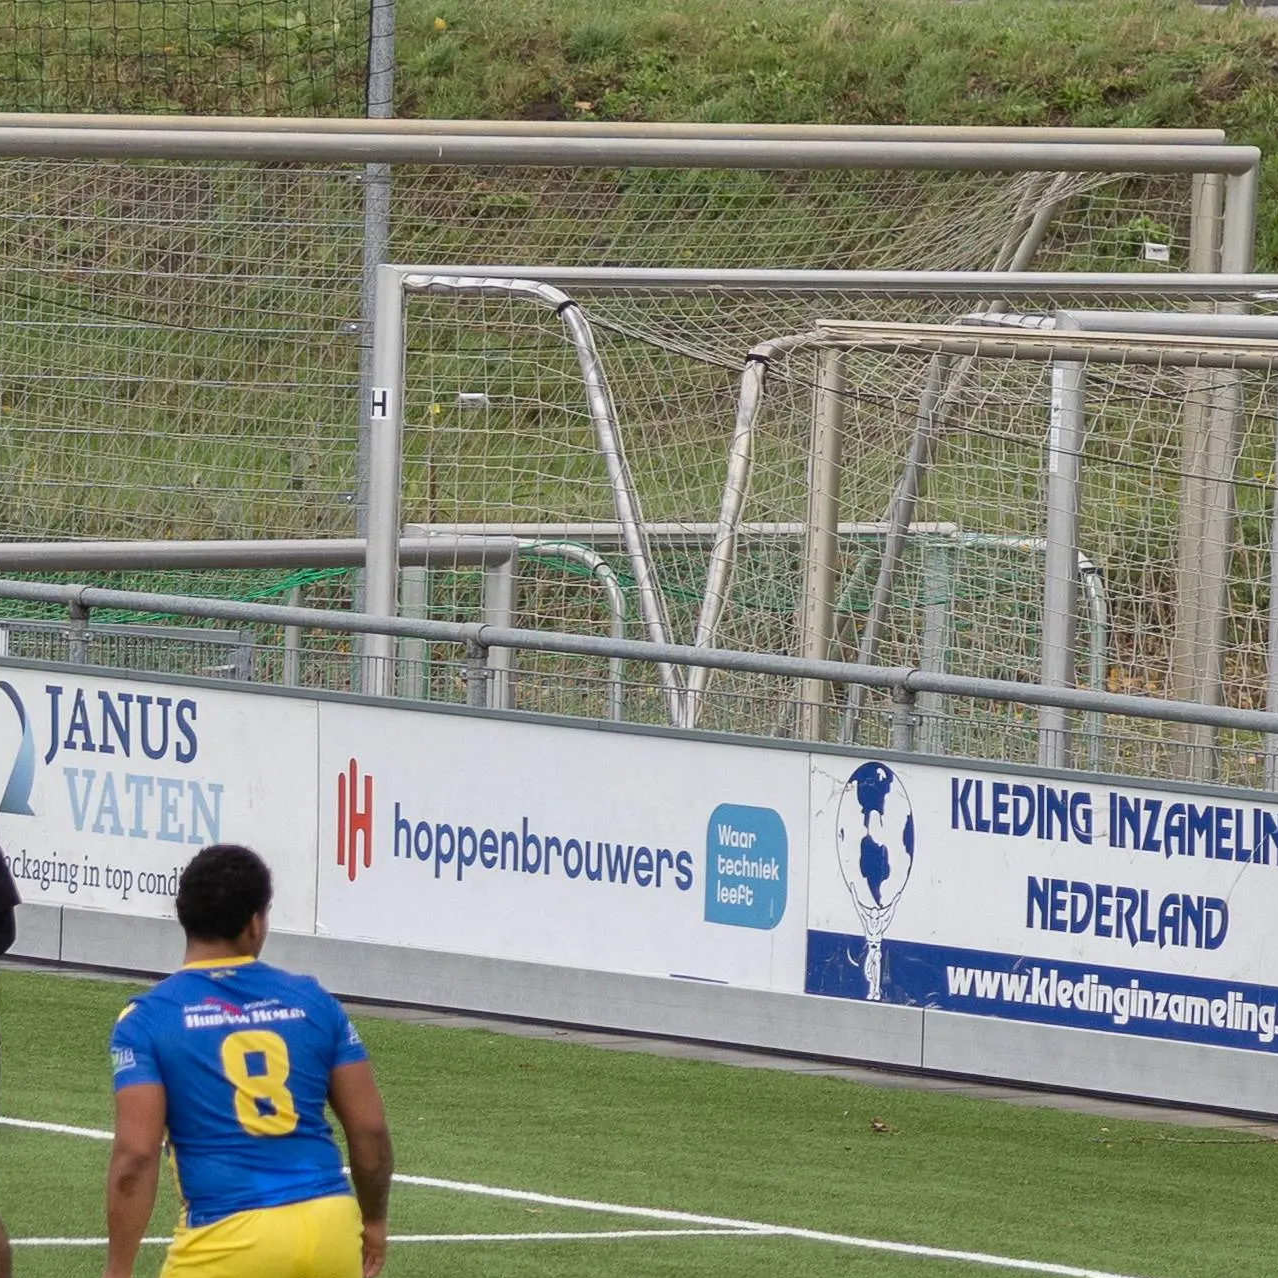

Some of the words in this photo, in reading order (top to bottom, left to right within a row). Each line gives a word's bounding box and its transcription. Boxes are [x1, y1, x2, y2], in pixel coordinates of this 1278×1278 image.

[372, 391, 386, 416] H
[45, 685, 198, 765] JANUS
[63, 767, 224, 846] VATEN
[718, 824, 756, 848] Waar
[951, 777, 1093, 845] KLEDING
[83, 856, 100, 887] in
[106, 864, 133, 900] top
[394, 802, 693, 891] hoppenbrouwers
[717, 854, 779, 880] techniek
[717, 879, 753, 906] leeft
[1026, 876, 1229, 950] NEDERLAND
[220, 1030, 300, 1136] 8
